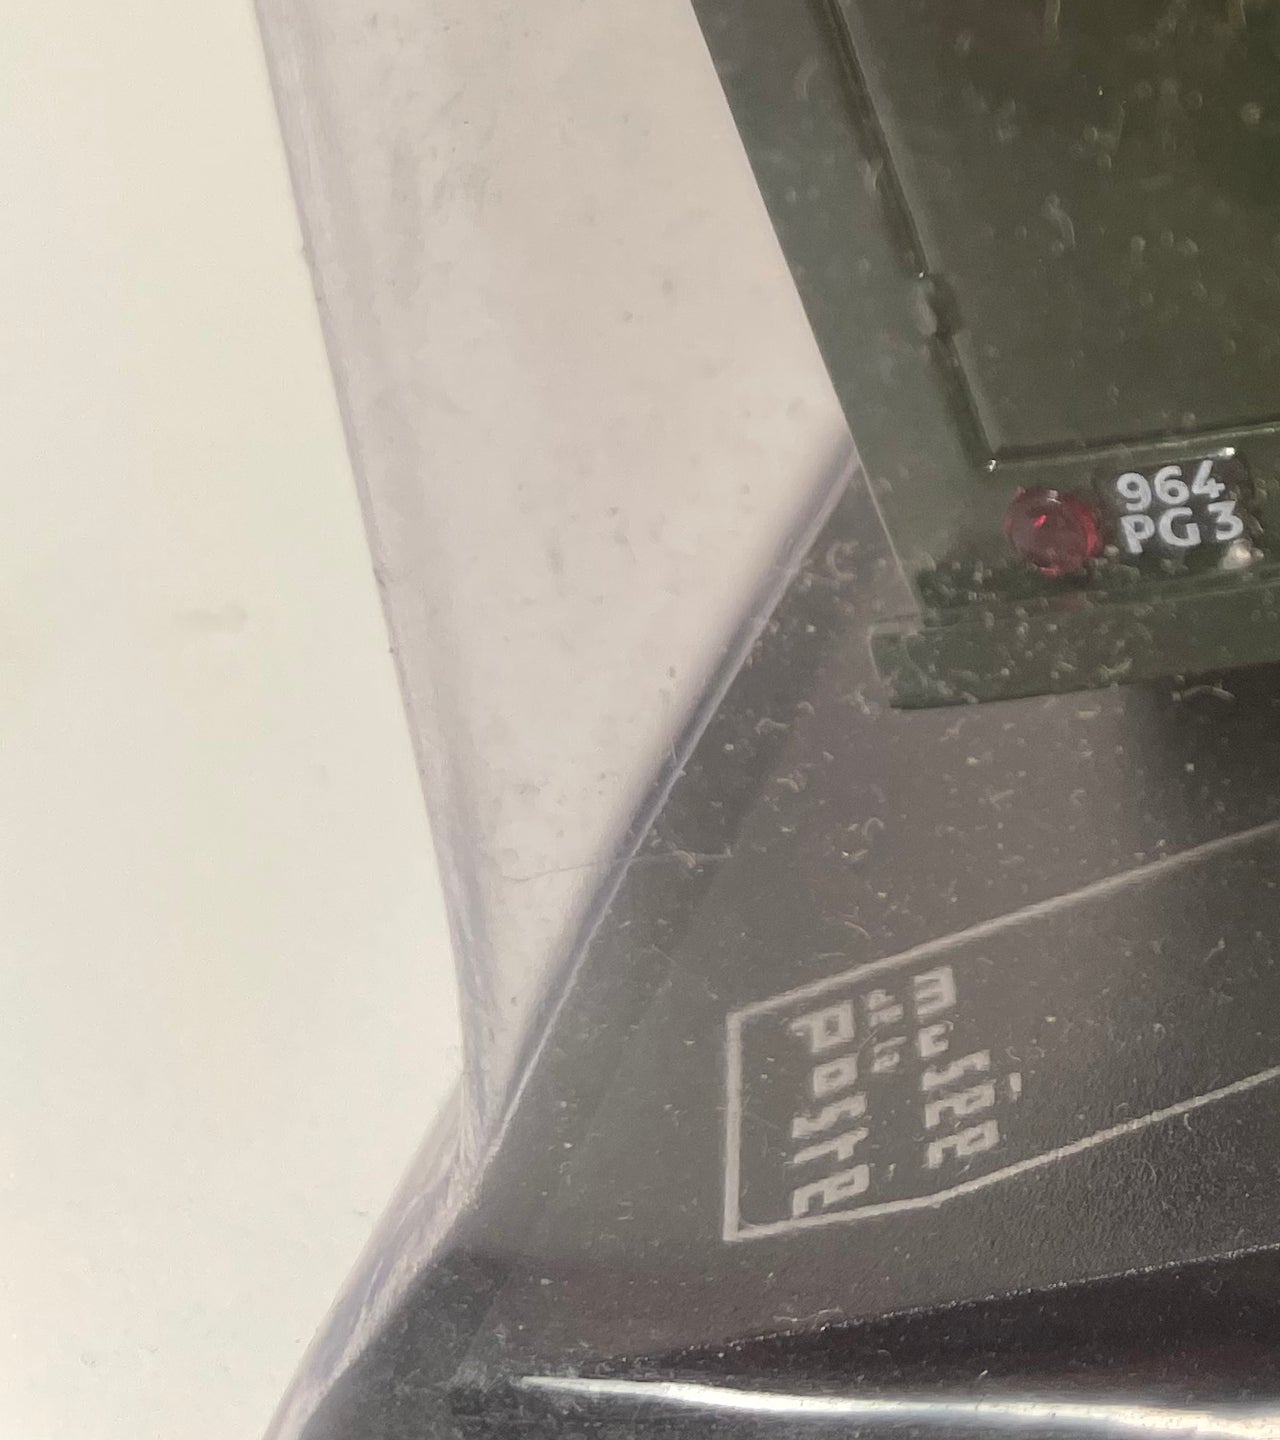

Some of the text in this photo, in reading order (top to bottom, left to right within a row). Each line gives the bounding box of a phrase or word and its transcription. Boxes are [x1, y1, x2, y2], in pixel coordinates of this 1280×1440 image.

[1115, 459, 1226, 511] 964
[1119, 499, 1245, 555] PG 3
